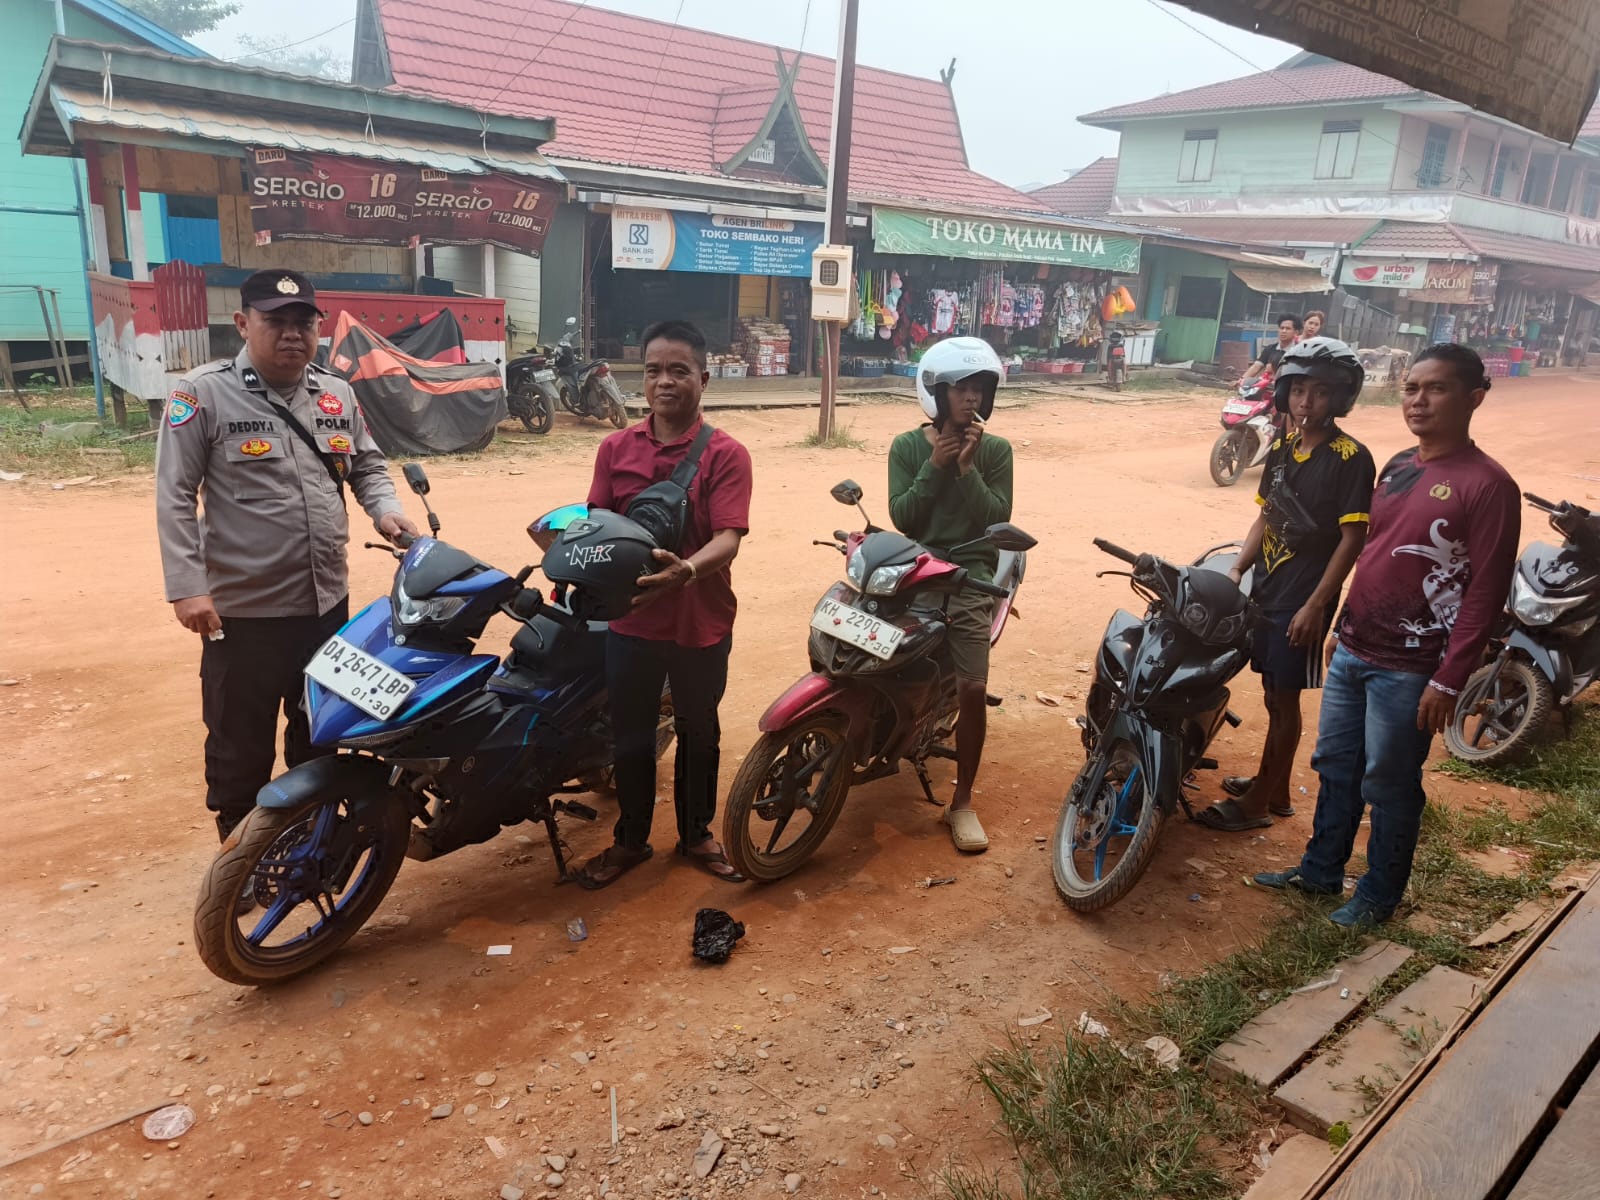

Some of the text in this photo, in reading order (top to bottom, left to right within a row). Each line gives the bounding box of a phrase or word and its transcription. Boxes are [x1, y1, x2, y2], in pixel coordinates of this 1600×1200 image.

[258, 150, 284, 161] BARU
[423, 170, 446, 180] BARU
[253, 173, 397, 200] SERGIO 16
[272, 200, 325, 211] KRETEK
[415, 190, 540, 211] SERGIO 16
[357, 204, 396, 218] 12.000
[426, 210, 472, 219] KRETEK
[498, 212, 533, 228] 12.000
[722, 217, 748, 226] AGEN
[700, 229, 804, 245] TOKO SEMBAKO HERI
[927, 217, 996, 244] TOKO
[1002, 224, 1065, 251] MAMA
[1070, 233, 1105, 257] INA
[1384, 265, 1415, 273] urban
[1424, 278, 1467, 289] JARUM
[228, 420, 274, 433] DEDDY.I
[316, 418, 350, 430] POLRI
[570, 544, 616, 570] NHK
[820, 600, 840, 617] KH
[845, 611, 881, 634] 2290
[323, 640, 410, 697] DA 2647 LBP
